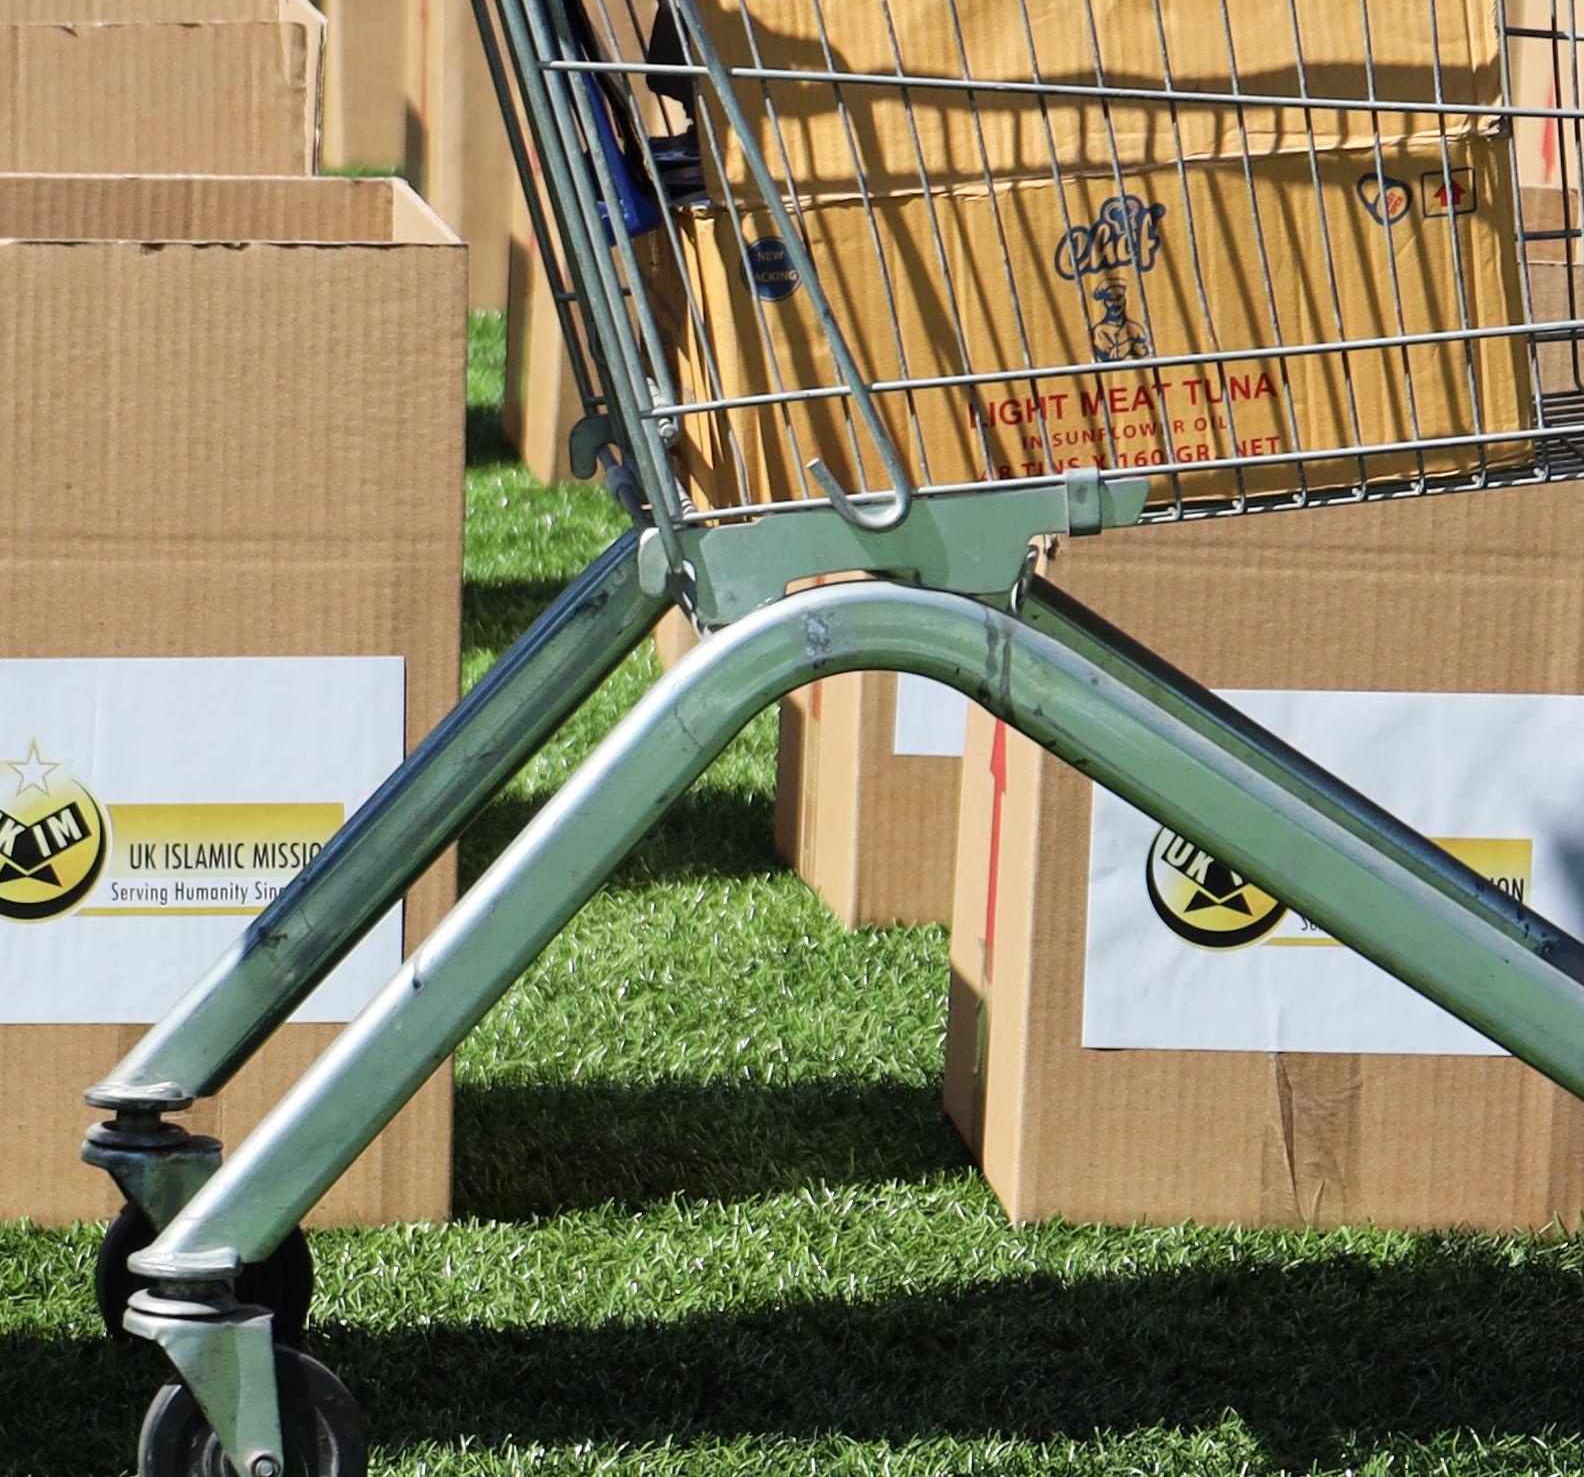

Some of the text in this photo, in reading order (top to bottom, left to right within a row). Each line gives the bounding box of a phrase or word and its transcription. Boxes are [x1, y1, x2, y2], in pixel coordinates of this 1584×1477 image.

[757, 250, 784, 262] NEW
[754, 269, 798, 283] ACKING
[968, 372, 1277, 429] LIGHT MEAT TUNA
[1053, 416, 1185, 447] SUNFLOWR
[1118, 448, 1163, 468] 160
[129, 842, 322, 870] UK ISLAMIC MISSIO
[111, 882, 168, 906] Serving
[175, 881, 248, 905] Humanity
